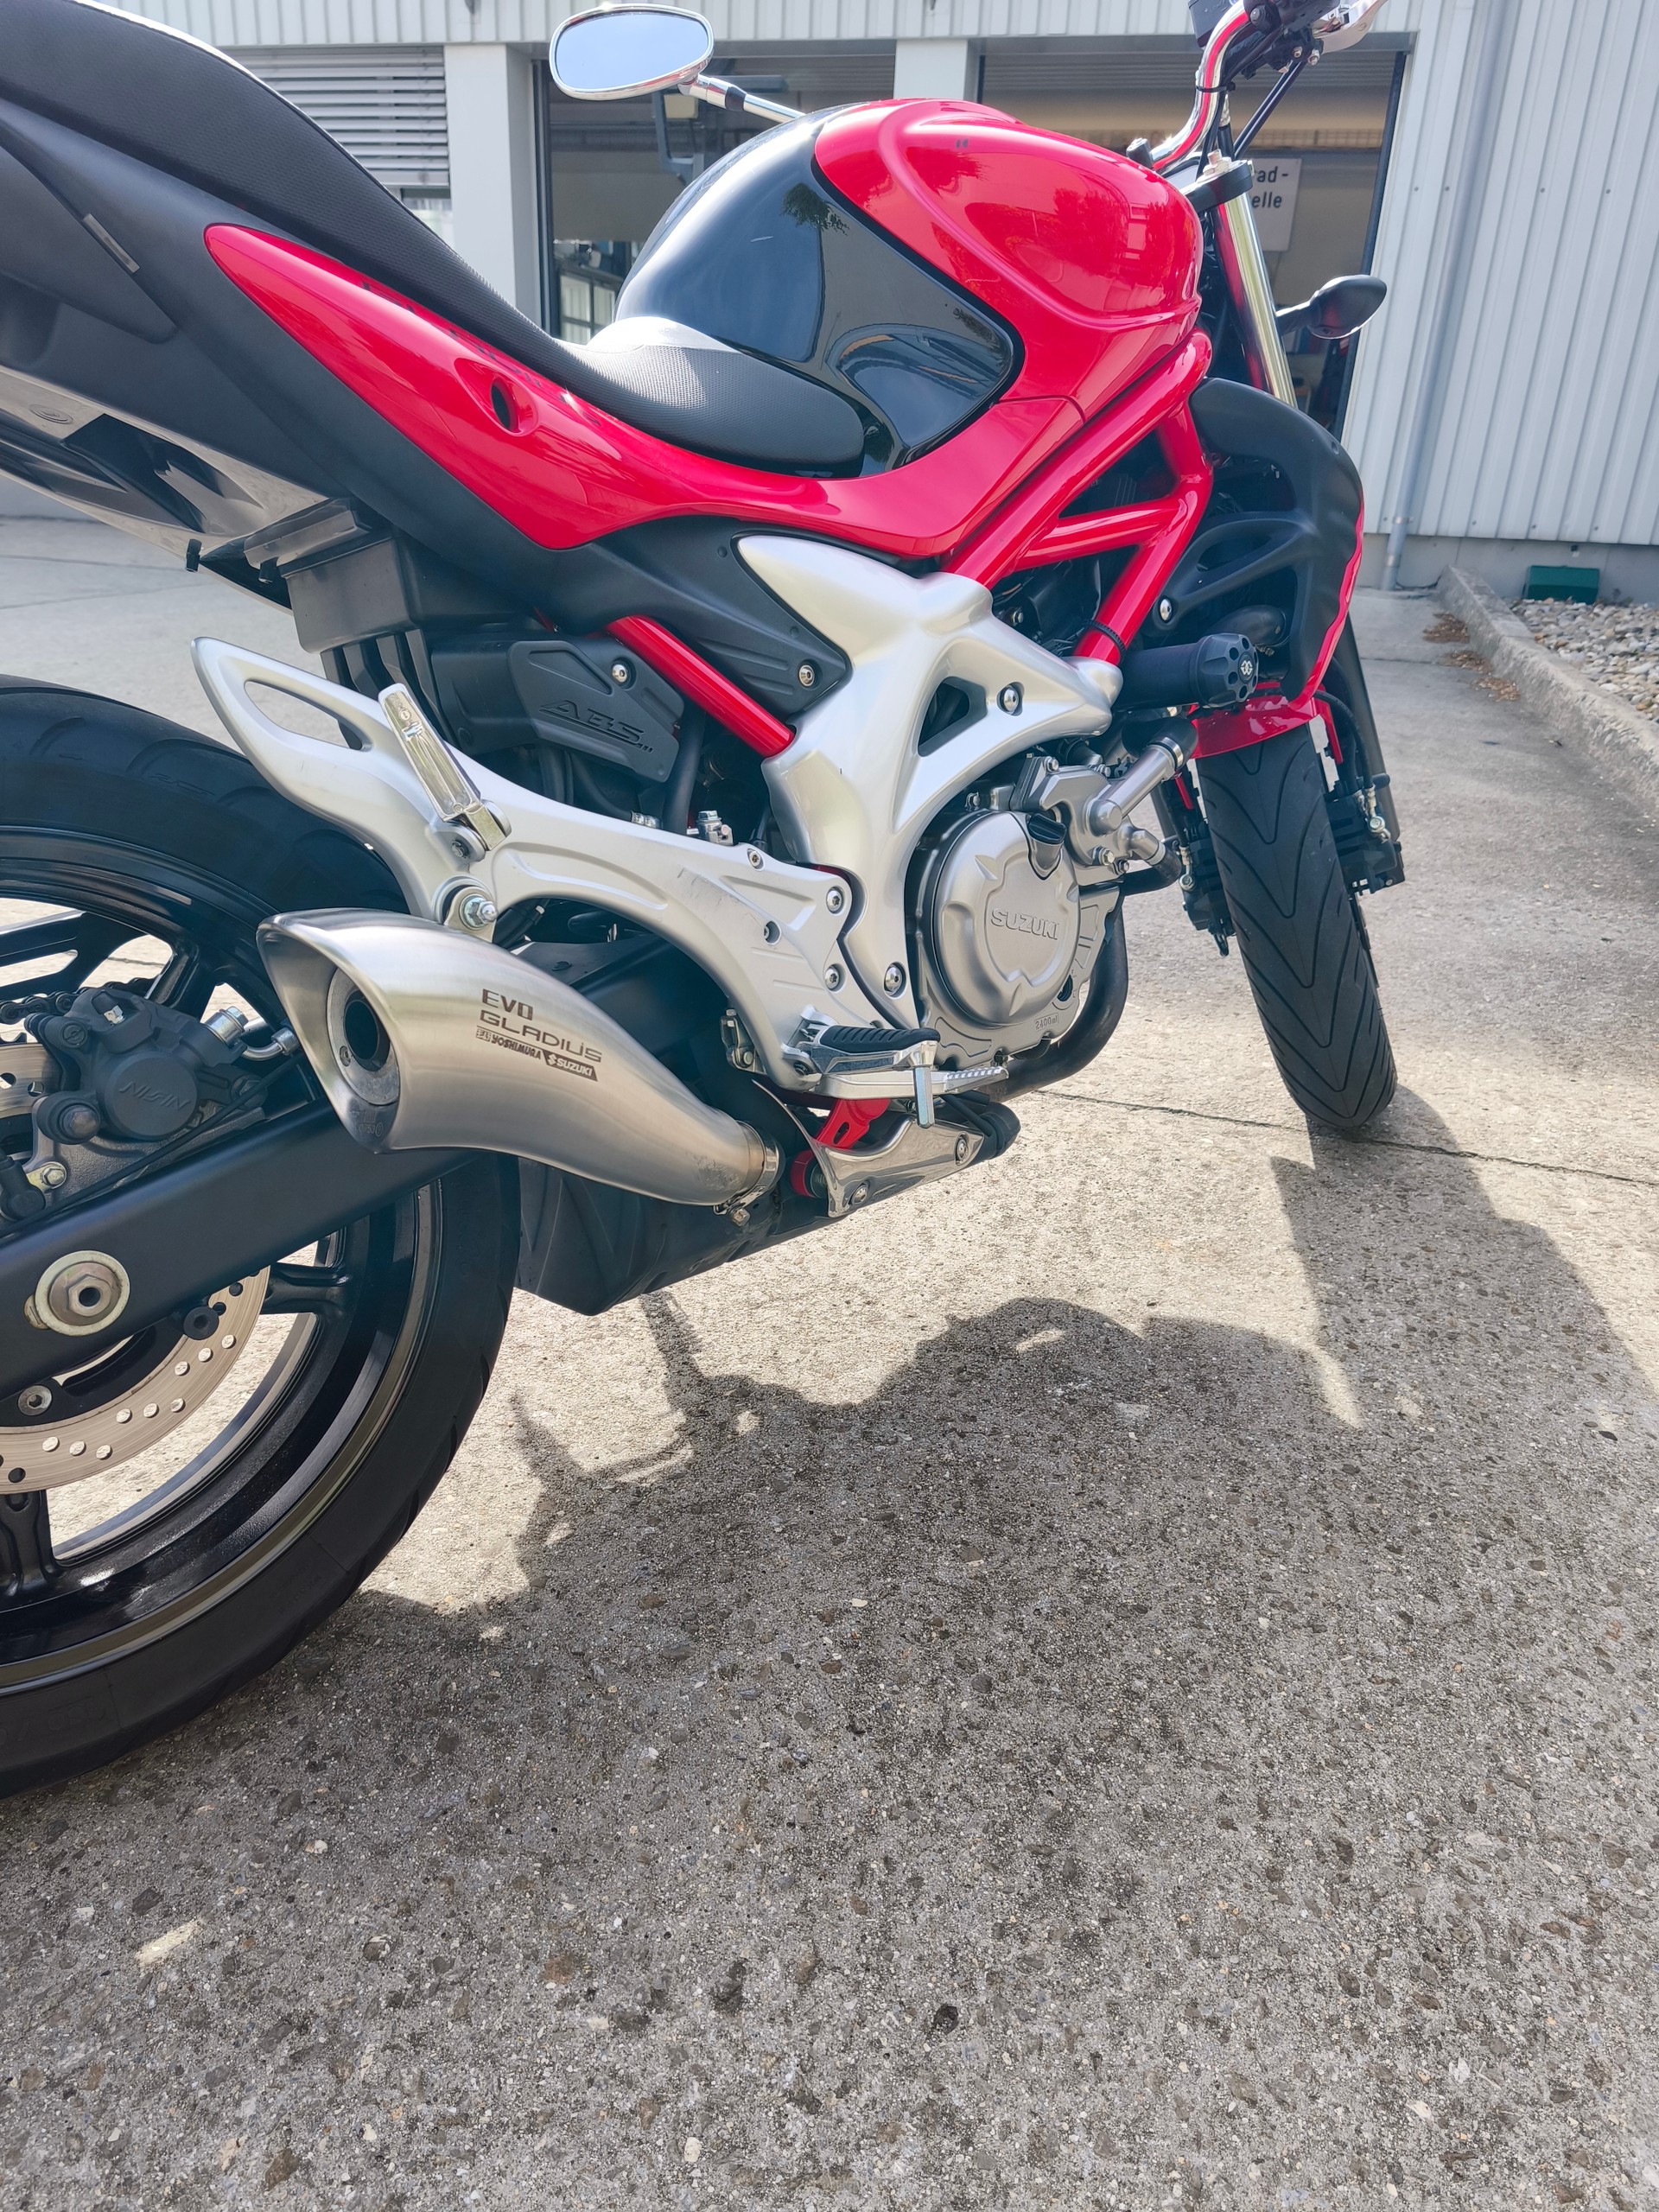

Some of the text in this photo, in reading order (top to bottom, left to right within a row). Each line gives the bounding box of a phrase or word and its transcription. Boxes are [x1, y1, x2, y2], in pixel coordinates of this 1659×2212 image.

[1255, 166, 1288, 182] ad-
[539, 699, 645, 743] ABS
[990, 908, 1060, 940] SUZUKI
[482, 988, 534, 1020] EVO
[480, 1009, 603, 1063] GLADIUS
[491, 1033, 542, 1060] YOSHIMURA
[556, 1058, 593, 1077] SUZUKI
